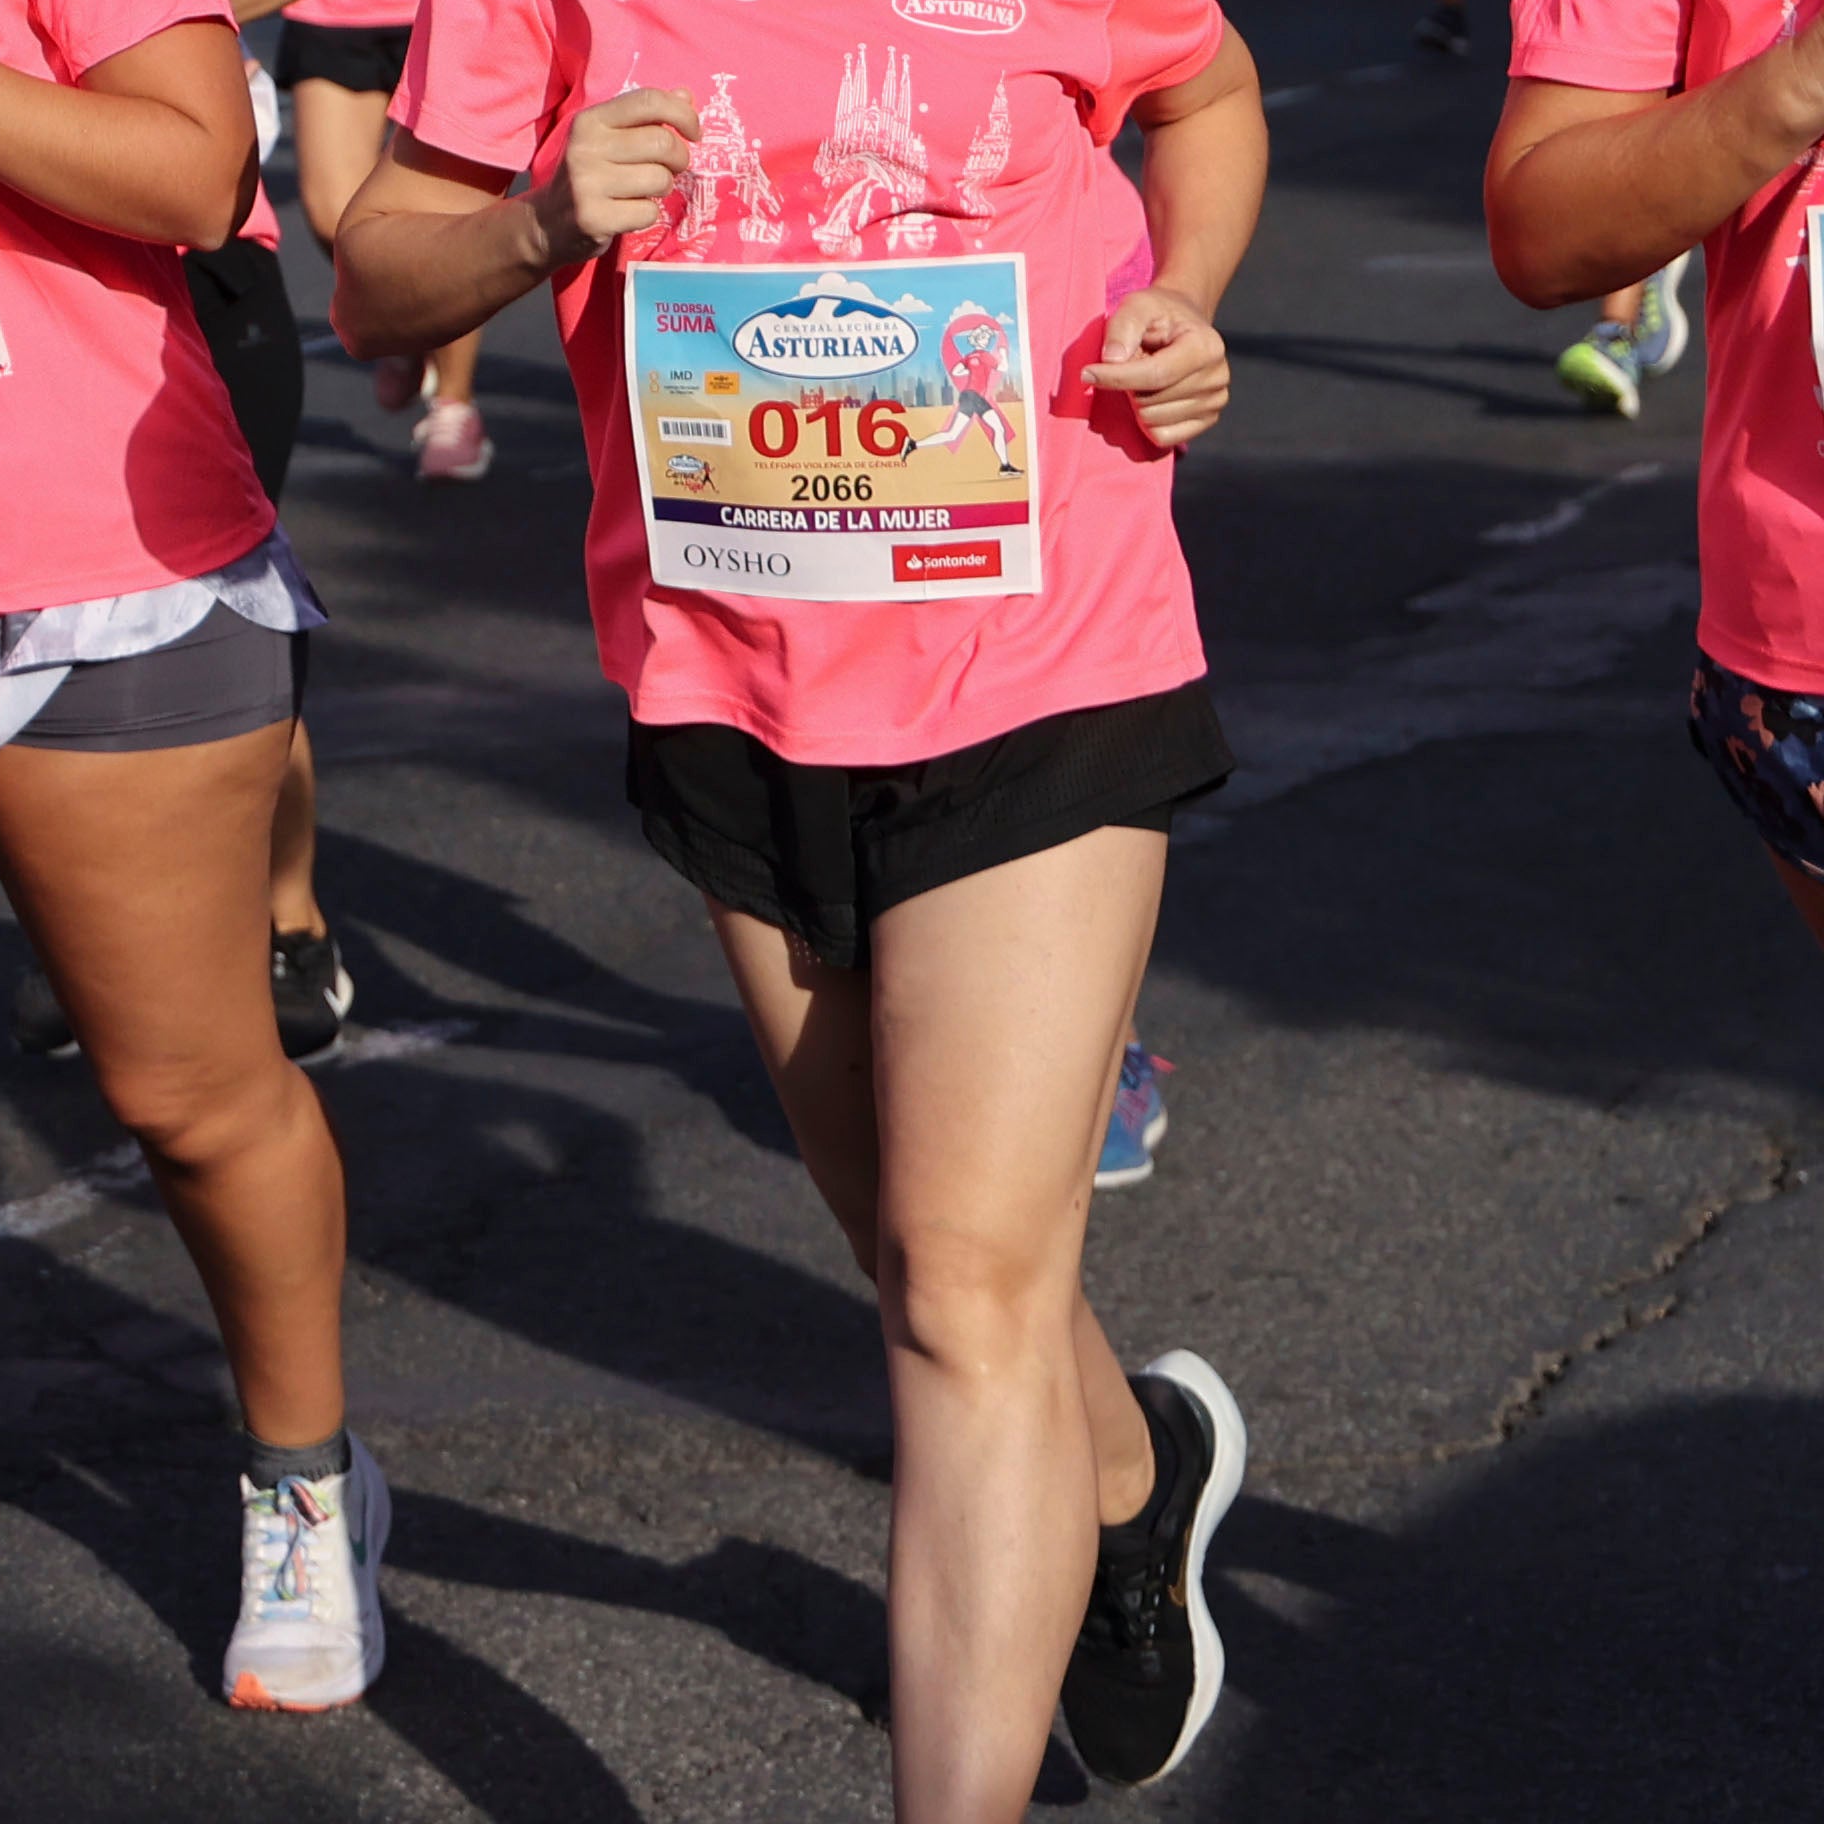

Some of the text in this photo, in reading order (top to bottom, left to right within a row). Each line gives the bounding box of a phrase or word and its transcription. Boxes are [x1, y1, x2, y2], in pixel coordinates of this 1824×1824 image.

[656, 302, 716, 315] TU DORSAL
[656, 314, 717, 334] SUMA
[773, 322, 899, 333] CENTRAL LECHERA
[746, 326, 906, 358] ASTURIANA
[670, 370, 693, 381] IMD
[748, 399, 911, 458] 016
[754, 460, 908, 470] TELÉFONO VIOLENCIA DE GÉNERO
[791, 474, 874, 502] 2066
[720, 507, 951, 531] CARRERA DE LA MUJER
[683, 543, 792, 577] OYSHO
[923, 552, 988, 569] Santander
